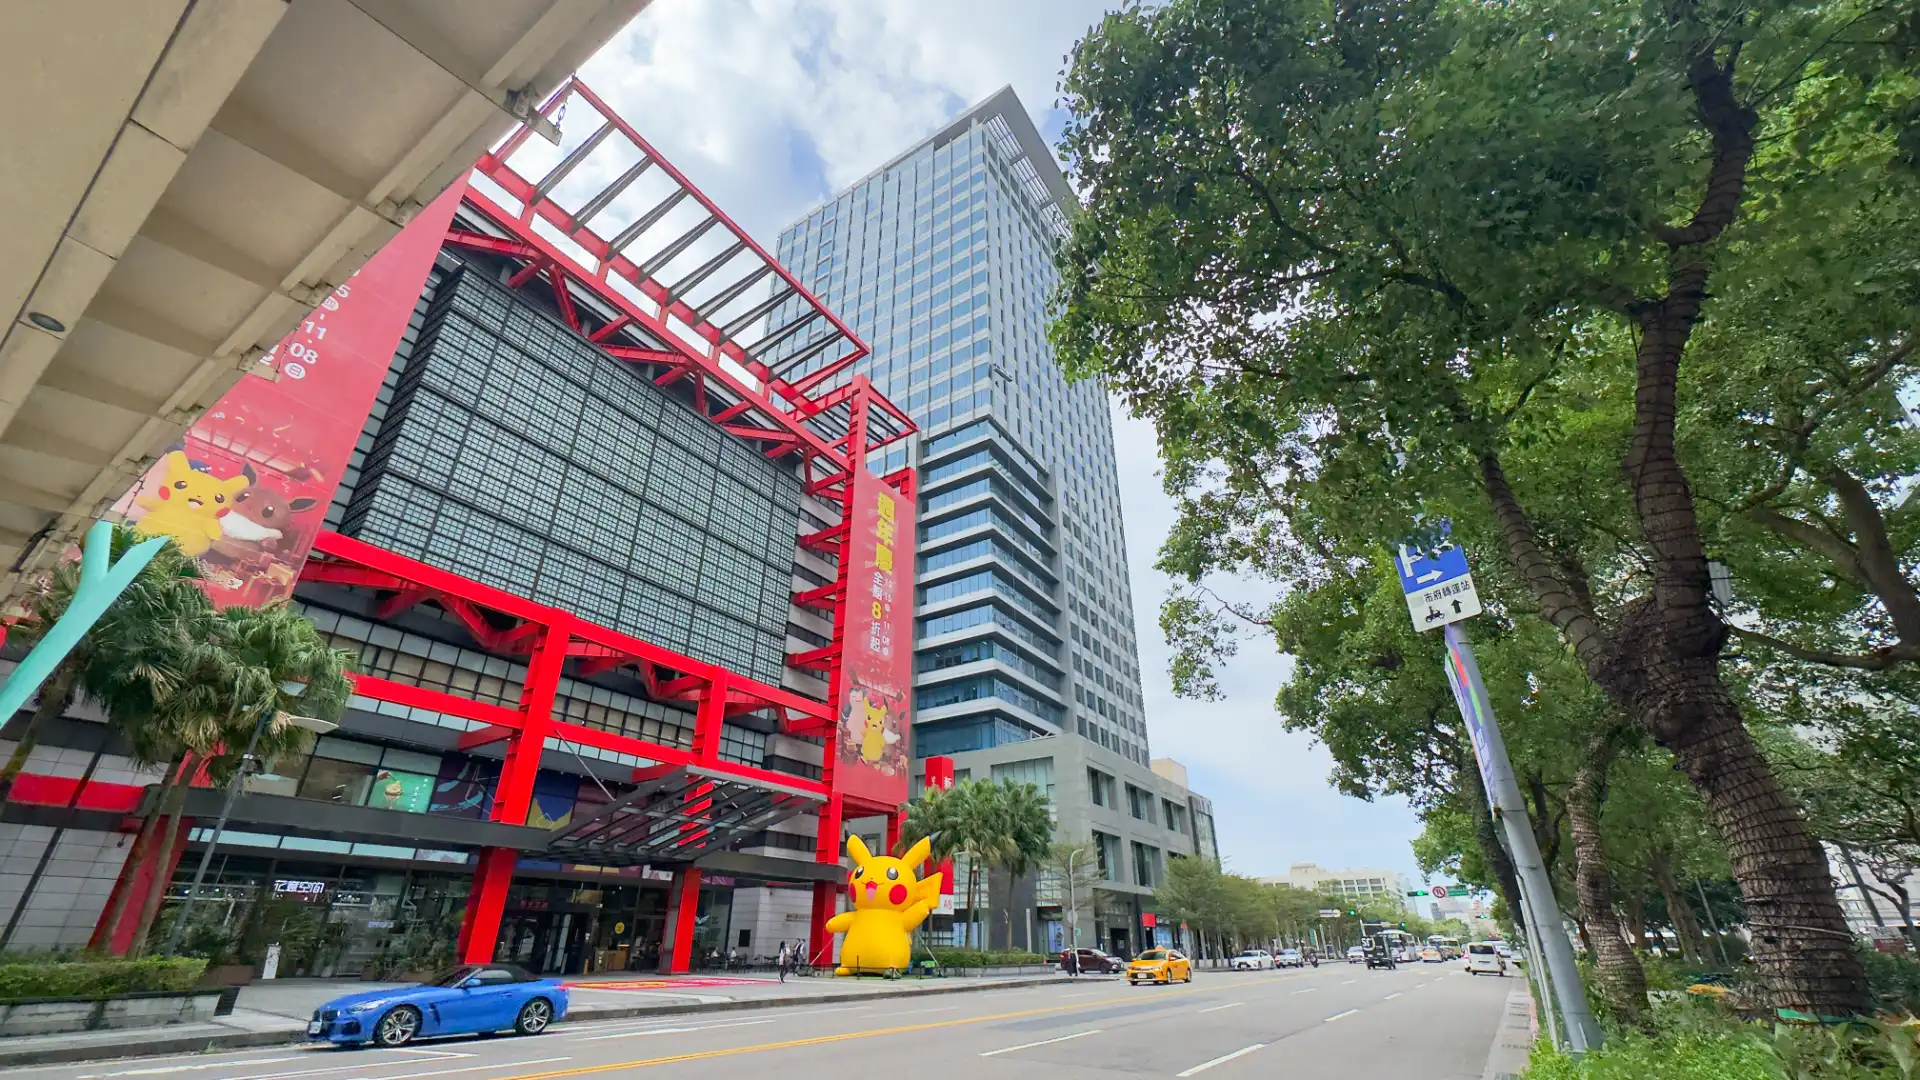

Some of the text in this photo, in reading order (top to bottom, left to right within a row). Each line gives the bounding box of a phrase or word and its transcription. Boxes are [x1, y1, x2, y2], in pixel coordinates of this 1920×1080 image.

[305, 320, 327, 340] 11
[290, 342, 318, 365] 08
[1424, 580, 1471, 603] 市府轉運站
